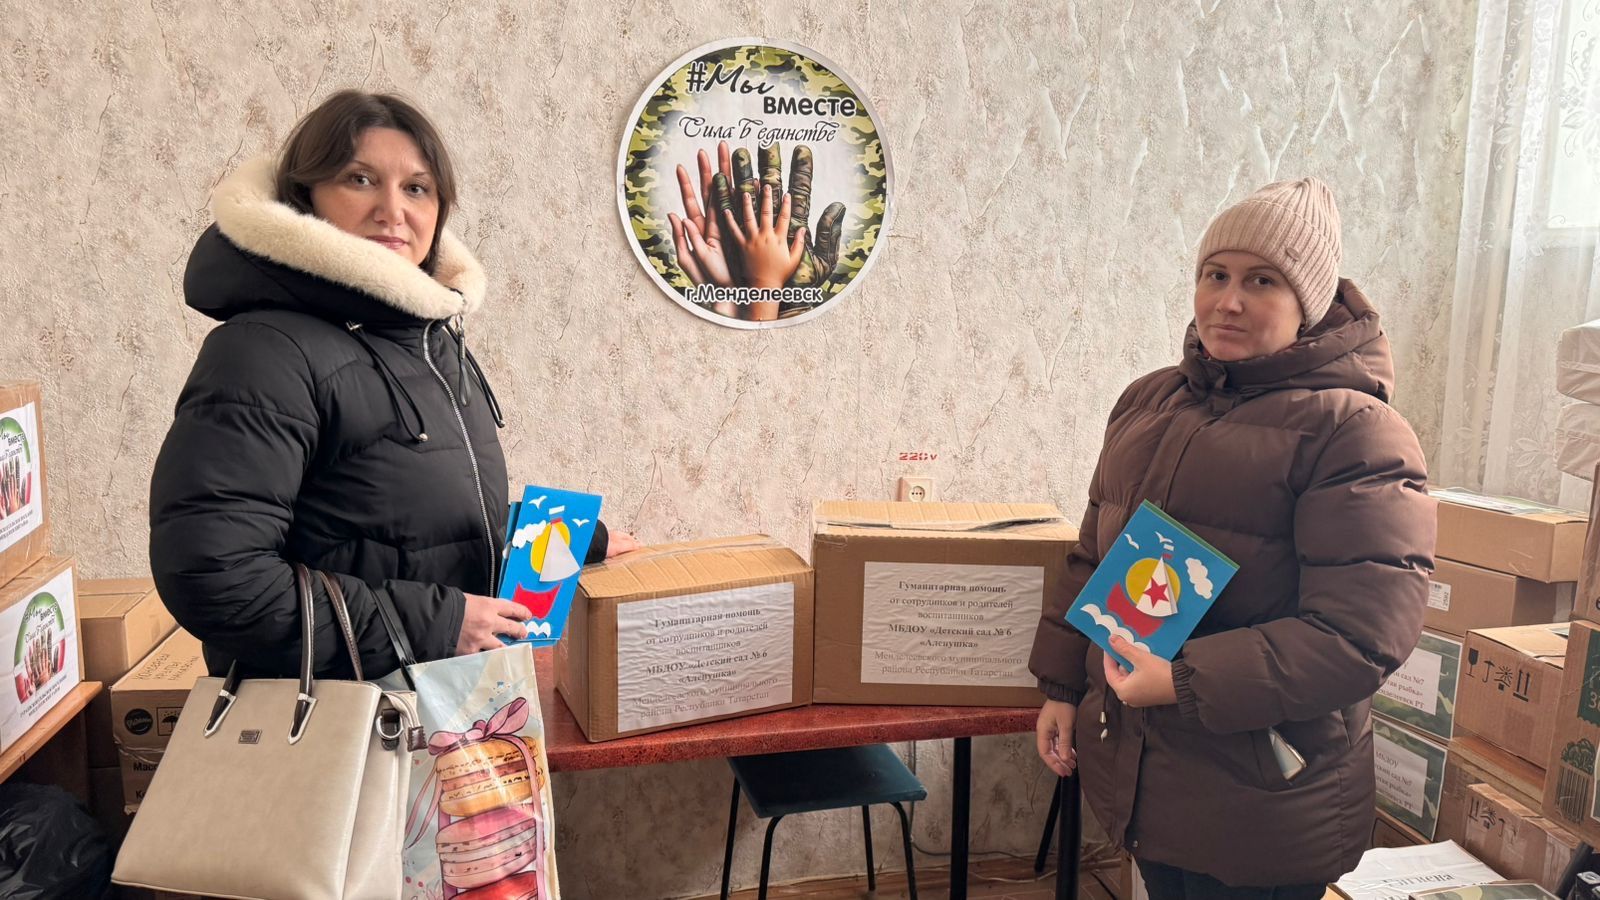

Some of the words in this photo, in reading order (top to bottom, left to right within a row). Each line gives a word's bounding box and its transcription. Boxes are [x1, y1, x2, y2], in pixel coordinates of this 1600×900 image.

[686, 61, 774, 94] #Мы
[763, 96, 856, 116] вместе
[680, 116, 735, 138] Сила
[758, 121, 840, 147] единстве
[686, 285, 822, 304] г.Менделеевск
[899, 581, 966, 592] Гуманитарная
[969, 585, 1007, 593] помощь
[902, 599, 958, 607] сотрудников
[968, 600, 1013, 609] родителей
[655, 613, 723, 629] Гуманитарная
[725, 609, 760, 618] помощь
[918, 612, 984, 621] воспитанников
[659, 631, 715, 644] сотрудников
[725, 621, 768, 636] родителей
[888, 624, 927, 634] МБДОУ
[993, 628, 1004, 636] №
[1006, 628, 1012, 636] 6
[675, 641, 741, 655] воспитанников
[647, 662, 686, 673] МБДОУ
[733, 655, 748, 663] сад
[750, 651, 760, 660] №
[762, 650, 767, 658] 6
[970, 668, 1013, 677] Татарстан
[728, 692, 769, 705] Татарстан
